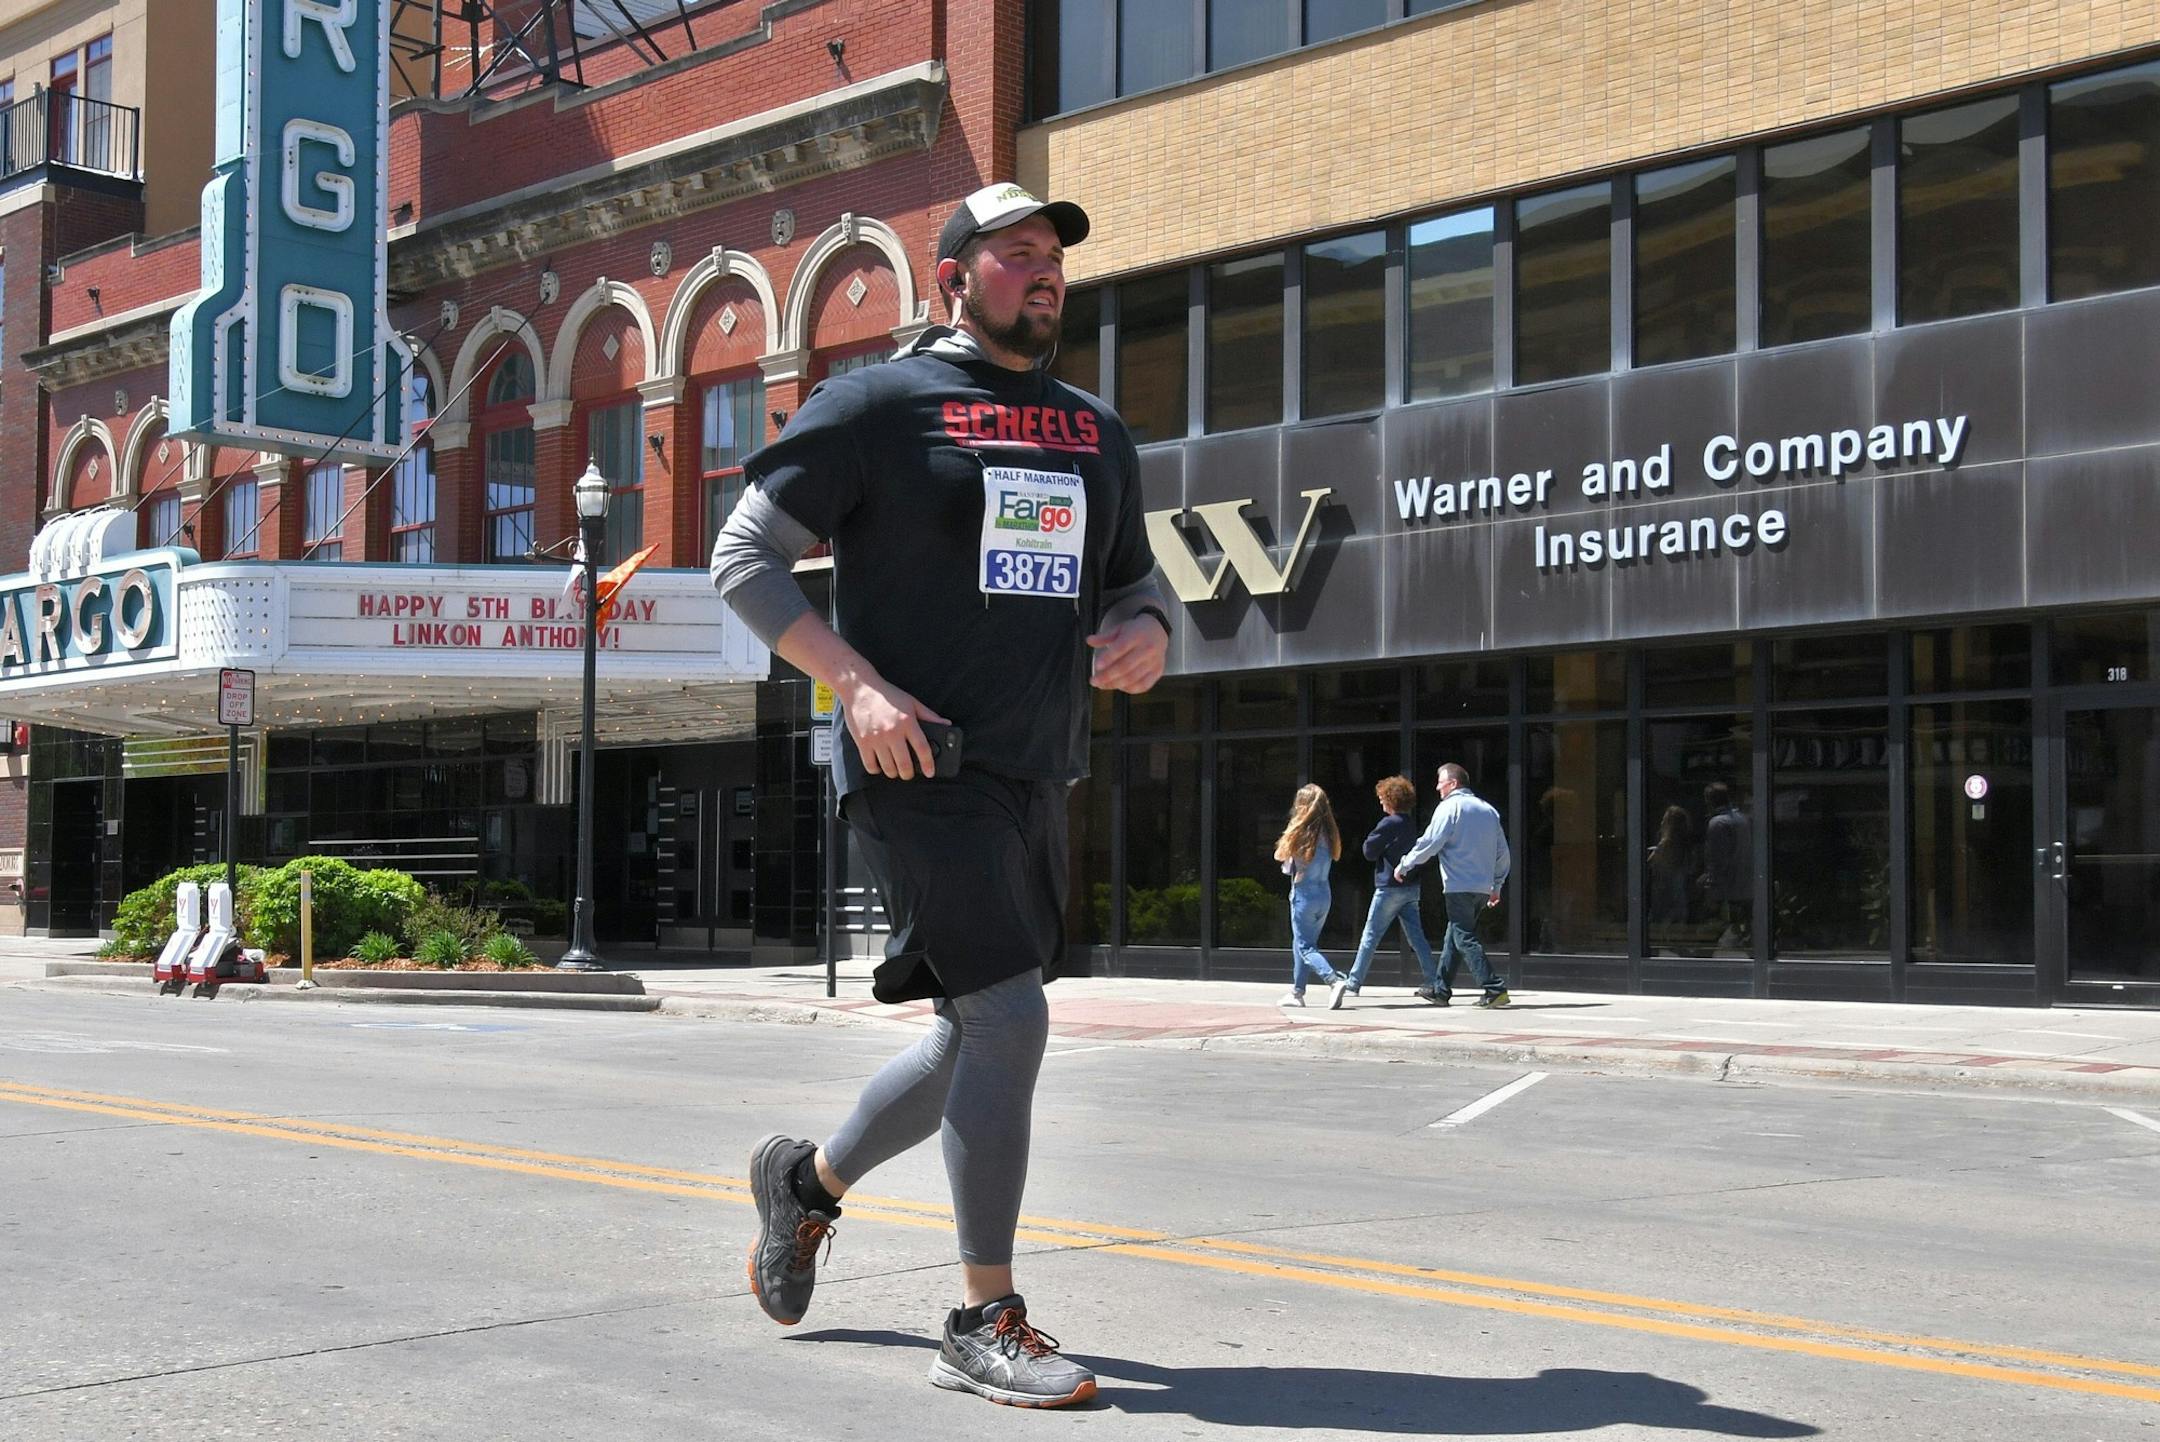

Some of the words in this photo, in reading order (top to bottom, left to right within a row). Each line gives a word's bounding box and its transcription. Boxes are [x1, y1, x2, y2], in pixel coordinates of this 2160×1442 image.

[942, 401, 1099, 444] SCHEELS
[994, 470, 1022, 482] HALF
[1023, 471, 1078, 485] MARATHON
[1394, 469, 1553, 521] Warner
[1581, 444, 1671, 497] and
[1704, 415, 1968, 484] Company
[999, 490, 1073, 533] Fargo
[1144, 487, 1334, 603] W
[1534, 509, 1787, 569] Insurance
[995, 552, 1071, 592] 3875
[0, 567, 153, 664] ARGO
[360, 595, 443, 617] HAPPY
[467, 597, 509, 619] 5TH
[393, 624, 481, 646] LINKON
[2107, 667, 2127, 682] 318
[226, 693, 248, 701] DROP
[229, 701, 245, 709] OFF
[226, 710, 247, 718] ZONE
